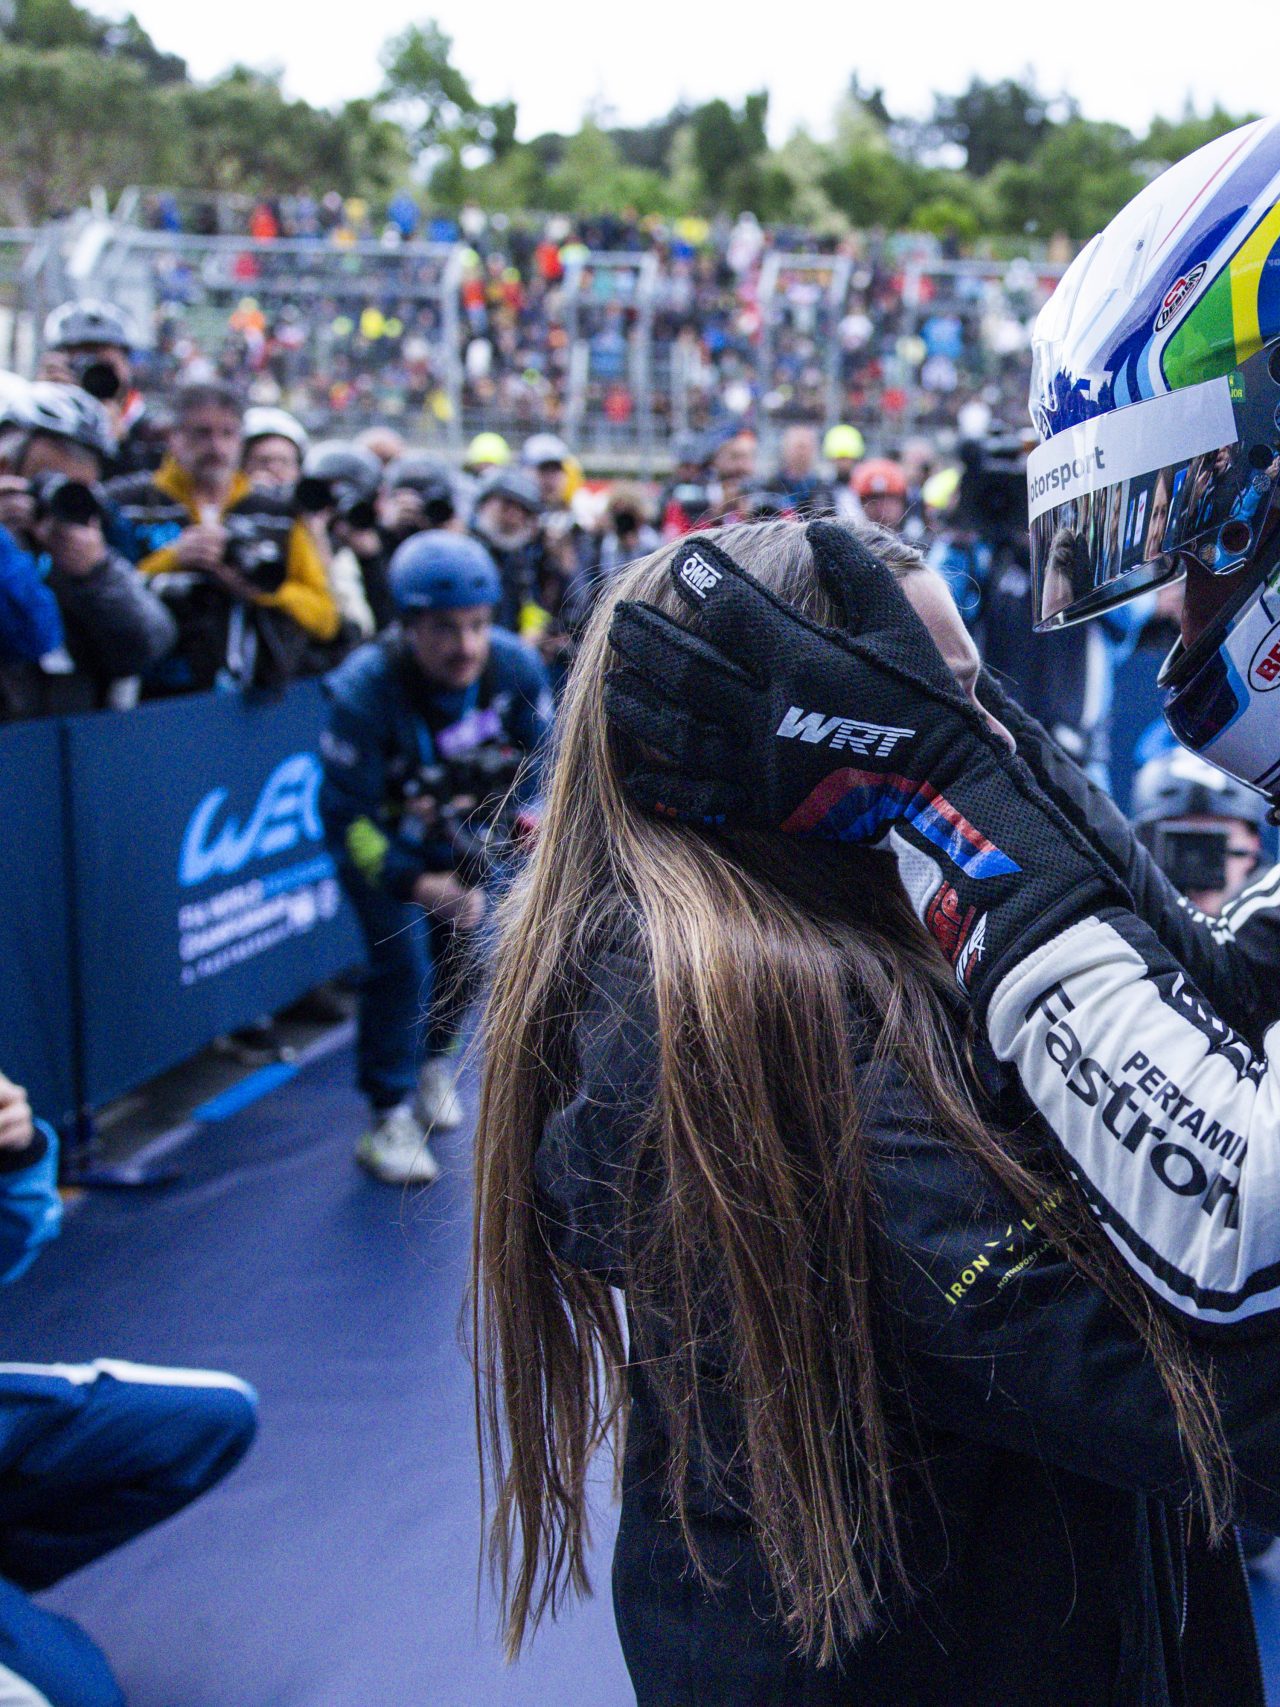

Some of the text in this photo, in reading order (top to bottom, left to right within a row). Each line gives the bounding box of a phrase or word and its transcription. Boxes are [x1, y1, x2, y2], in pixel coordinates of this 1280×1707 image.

[1030, 446, 1106, 503] otorsport
[681, 555, 718, 592] OMP
[776, 706, 917, 757] WRT
[1120, 1049, 1248, 1169] PERTAMI
[944, 1253, 991, 1306] IRON
